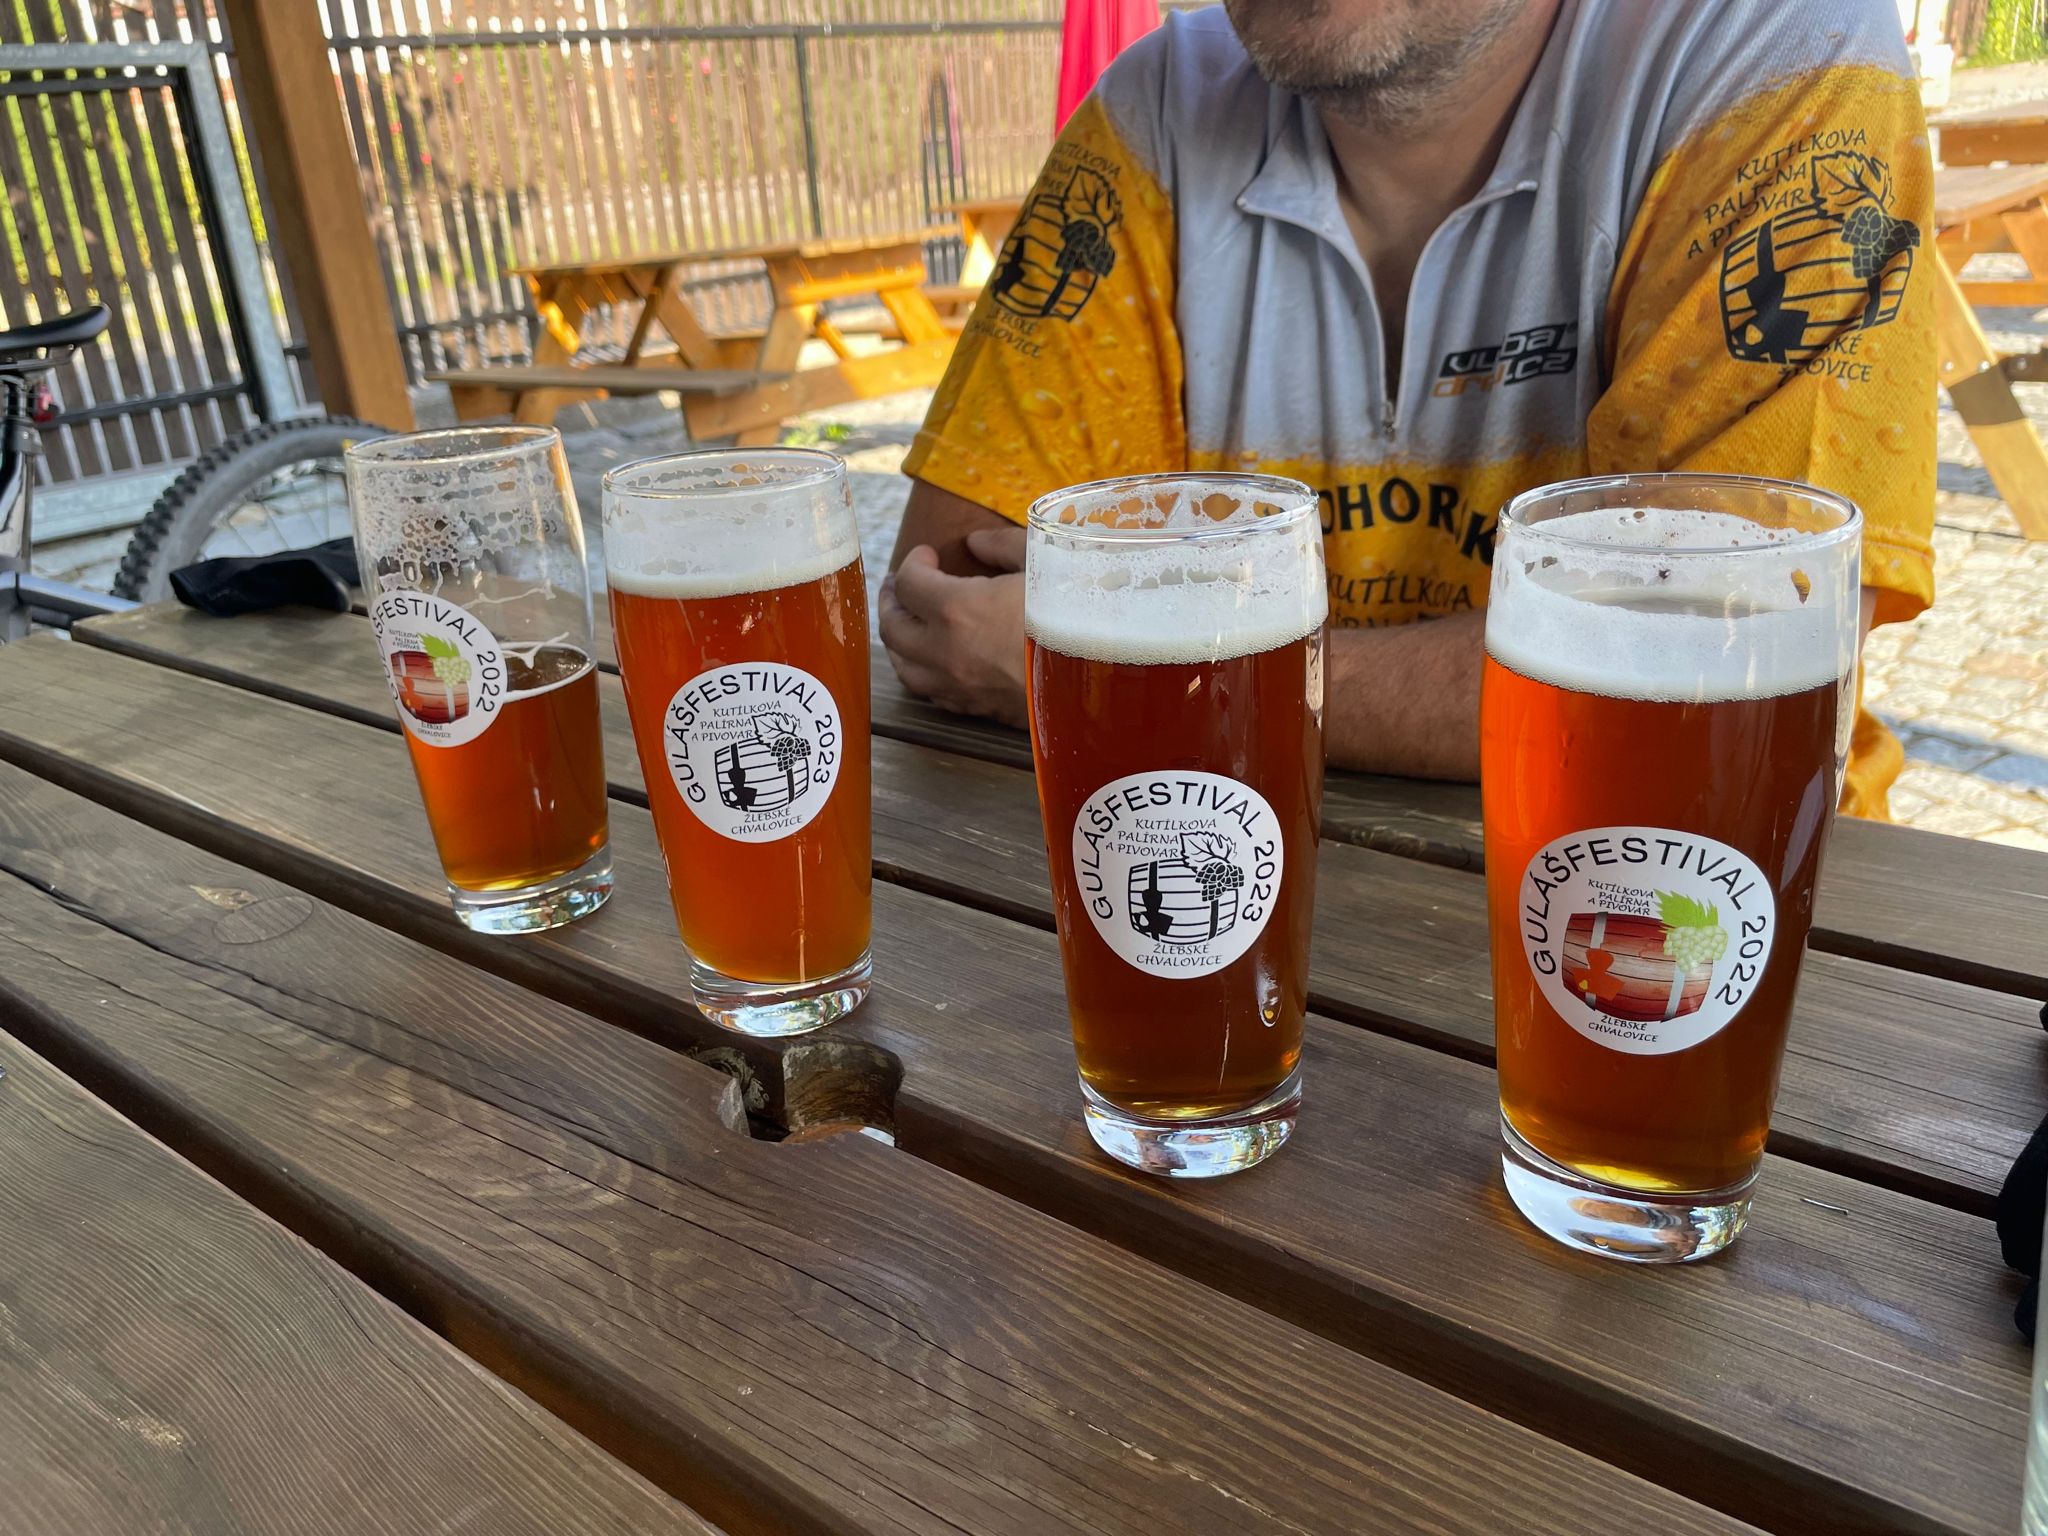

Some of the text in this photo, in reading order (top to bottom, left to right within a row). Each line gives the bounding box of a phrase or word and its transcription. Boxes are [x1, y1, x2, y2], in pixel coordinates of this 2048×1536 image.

[1687, 239, 1703, 260] A
[476, 650, 501, 713] 2022
[713, 700, 782, 718] KUTÍLKOVA
[700, 717, 752, 730] PALÍRNA
[667, 671, 835, 804] GULÁŠFESTIVAL 2023
[691, 729, 754, 742] A PIVOVAR
[744, 806, 792, 823] ŽLEBSKÉ
[731, 814, 803, 835] CHVALOVICE
[1135, 818, 1217, 831] KUTÍLKOVA
[1118, 830, 1179, 844] PALÍRNA
[1079, 781, 1275, 922] GULÁŠFESTIVAL 2023
[1106, 842, 1179, 858] A PIVOVAR
[1588, 878, 1655, 898] KUTÍLKOVA
[1588, 897, 1650, 916] A PIVOVAR
[1598, 891, 1650, 908] PALÍRNA
[1526, 837, 1767, 1006] GULÁŠFESTIVAL 2022
[1153, 942, 1210, 955] ŽLEBSKÉ
[1136, 954, 1223, 967] CHVALOVICE
[1600, 1014, 1648, 1032] ŽLEBSKÉ
[1588, 1022, 1659, 1043] CHVALOVICE
